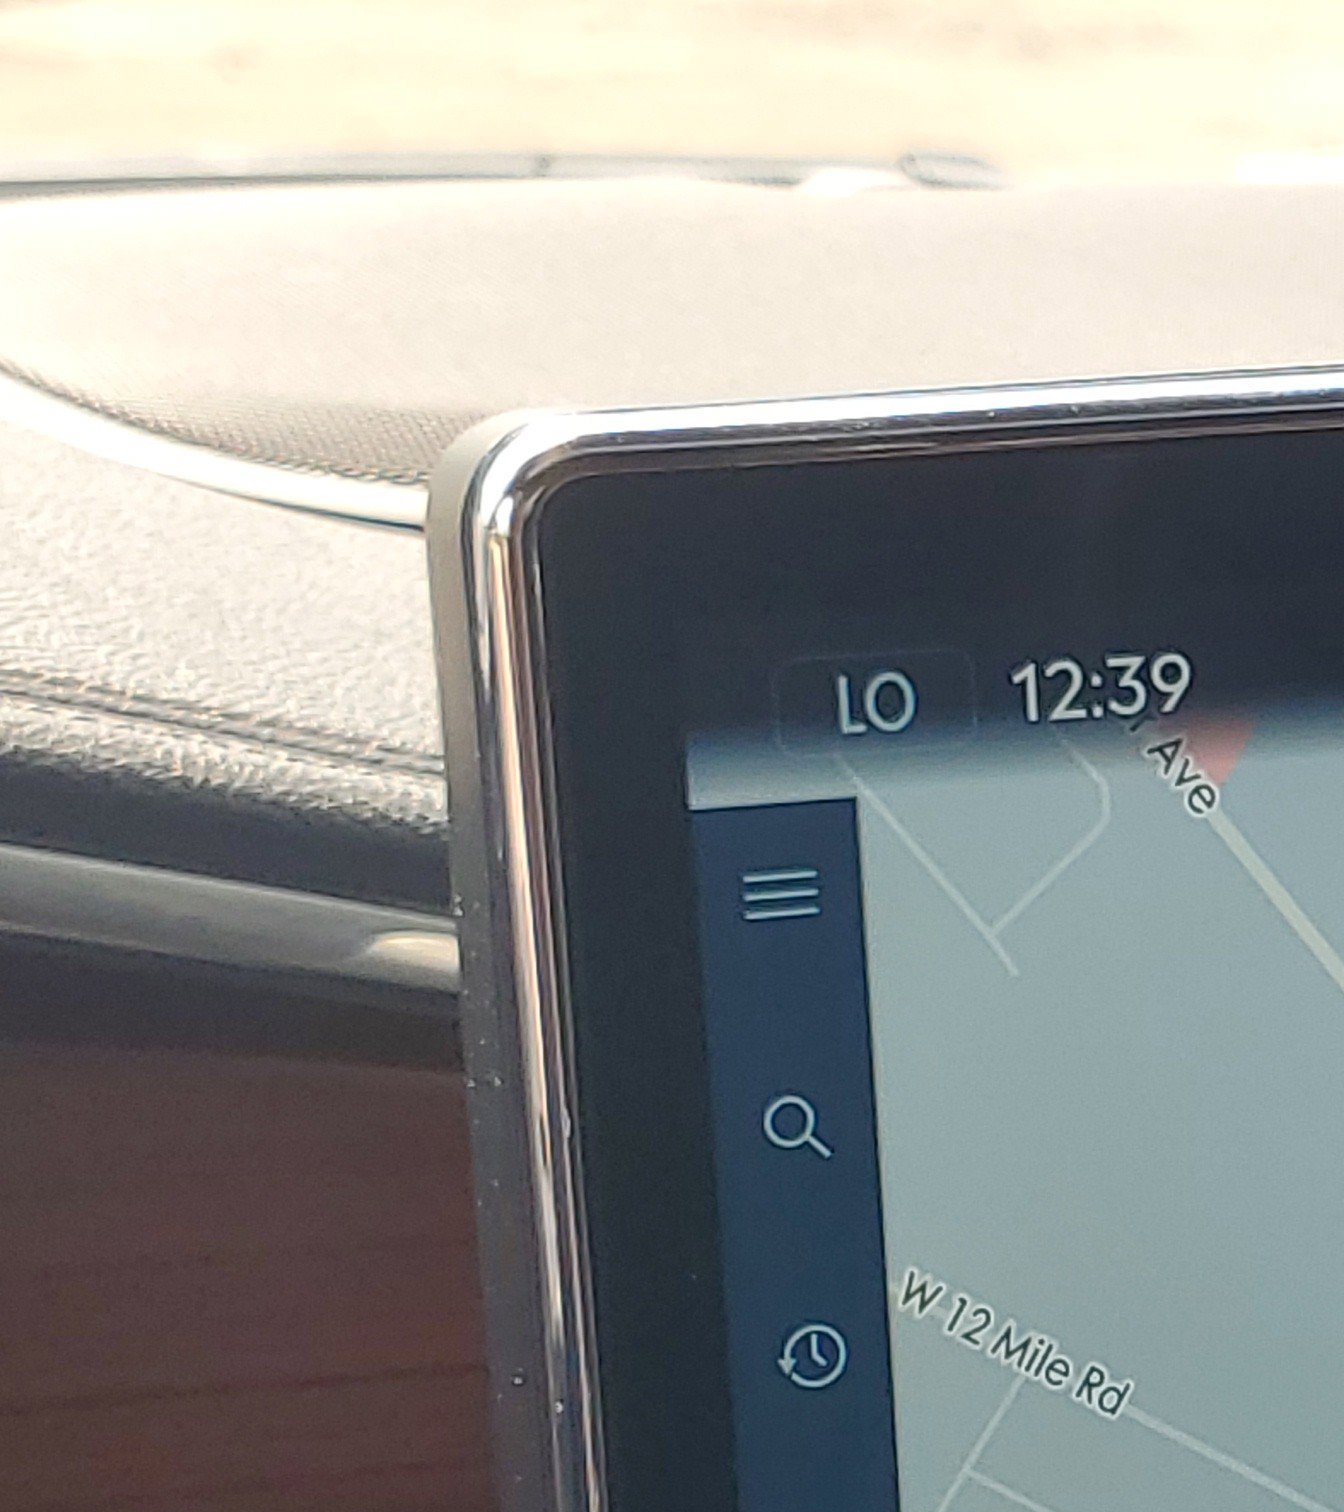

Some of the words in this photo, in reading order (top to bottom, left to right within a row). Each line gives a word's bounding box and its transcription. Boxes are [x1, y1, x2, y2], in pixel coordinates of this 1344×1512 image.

[836, 672, 916, 734] LO
[1011, 652, 1191, 722] 12:39
[1147, 738, 1216, 814] Ave
[901, 1271, 943, 1316] W
[947, 1297, 991, 1347] 12
[991, 1326, 1070, 1387] Mile
[1075, 1366, 1133, 1416] Rd
